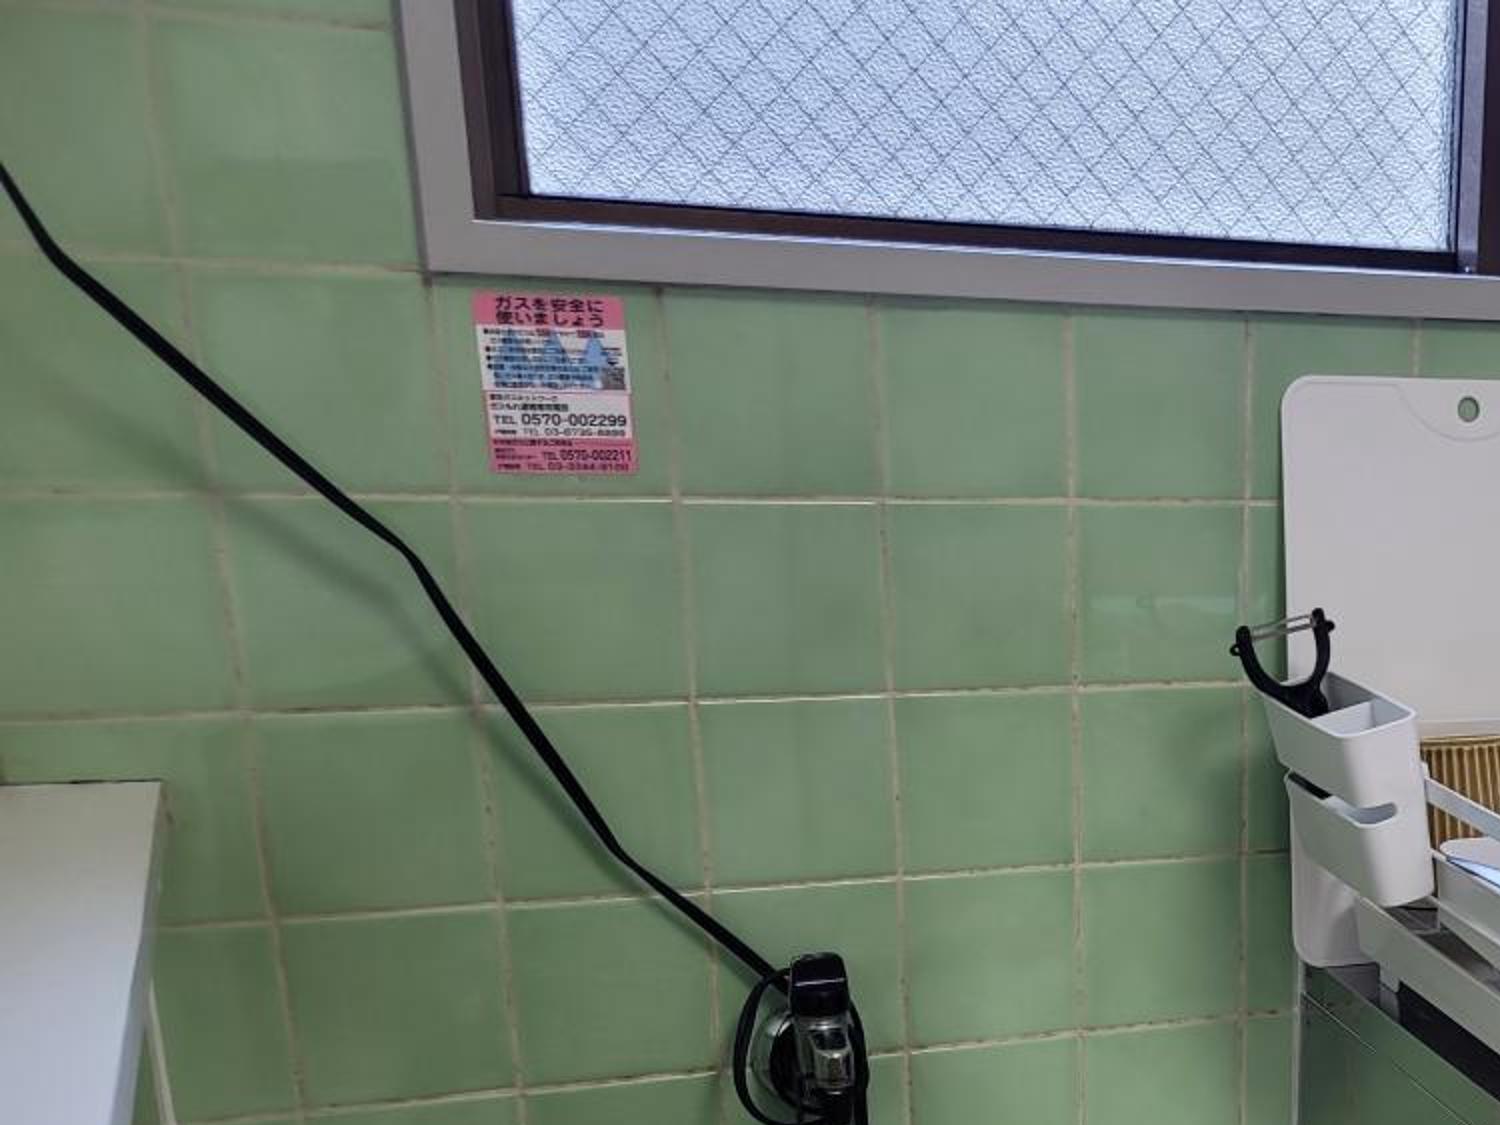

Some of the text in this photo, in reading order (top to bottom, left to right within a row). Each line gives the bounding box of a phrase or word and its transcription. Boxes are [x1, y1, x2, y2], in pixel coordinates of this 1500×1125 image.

[495, 296, 605, 313] ガスを安全に
[496, 311, 605, 328] 使いましょう
[494, 413, 627, 427] TEL 0570-002299
